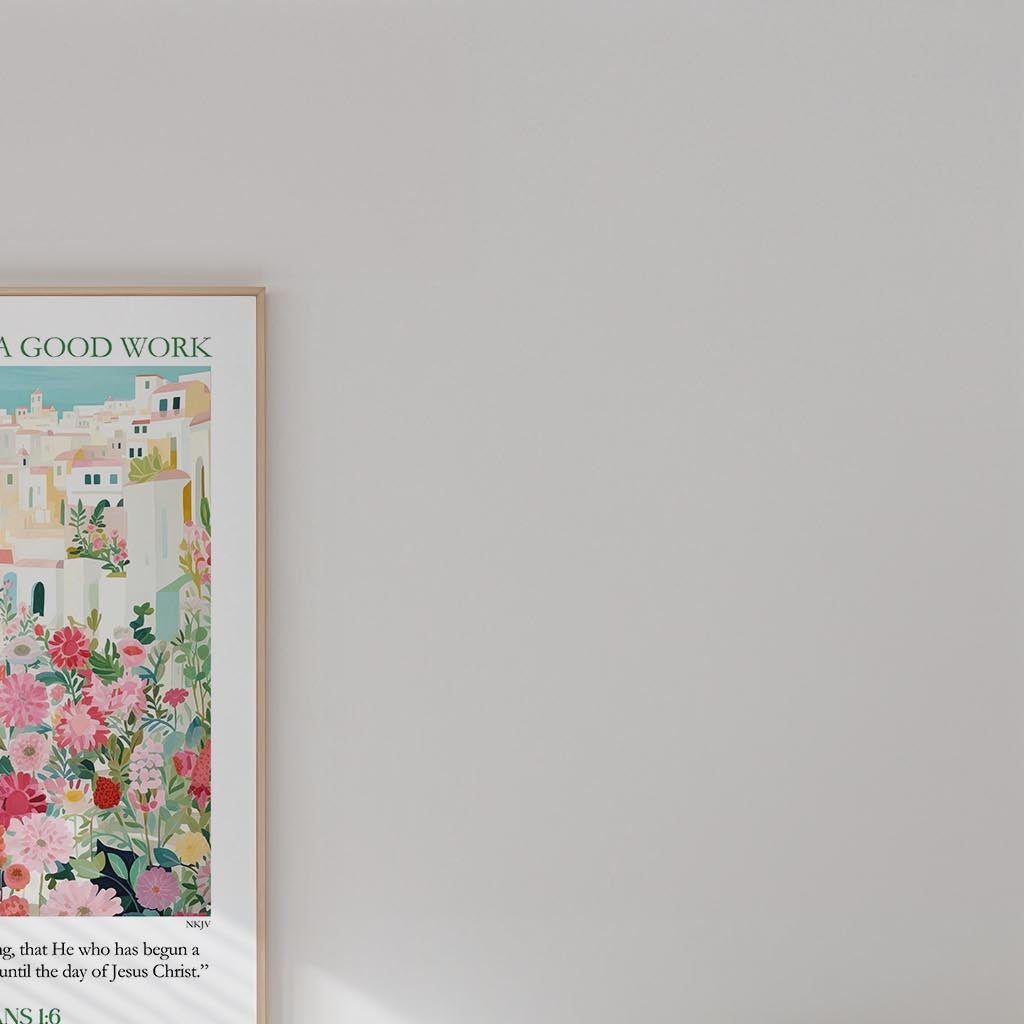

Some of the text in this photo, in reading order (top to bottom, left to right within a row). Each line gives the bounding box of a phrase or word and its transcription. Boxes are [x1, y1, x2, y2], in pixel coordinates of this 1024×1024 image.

[20, 336, 112, 358] GOOD
[120, 337, 214, 358] WORK
[186, 920, 211, 931] NKJV
[19, 941, 48, 956] that
[51, 941, 75, 956] He
[78, 941, 111, 956] who
[114, 941, 139, 956] has
[143, 941, 188, 960] begun
[191, 945, 201, 956] a
[35, 963, 59, 978] the
[62, 963, 88, 983] day
[91, 963, 110, 978] of
[108, 963, 149, 983] Jesus
[152, 963, 209, 978] Christ.”
